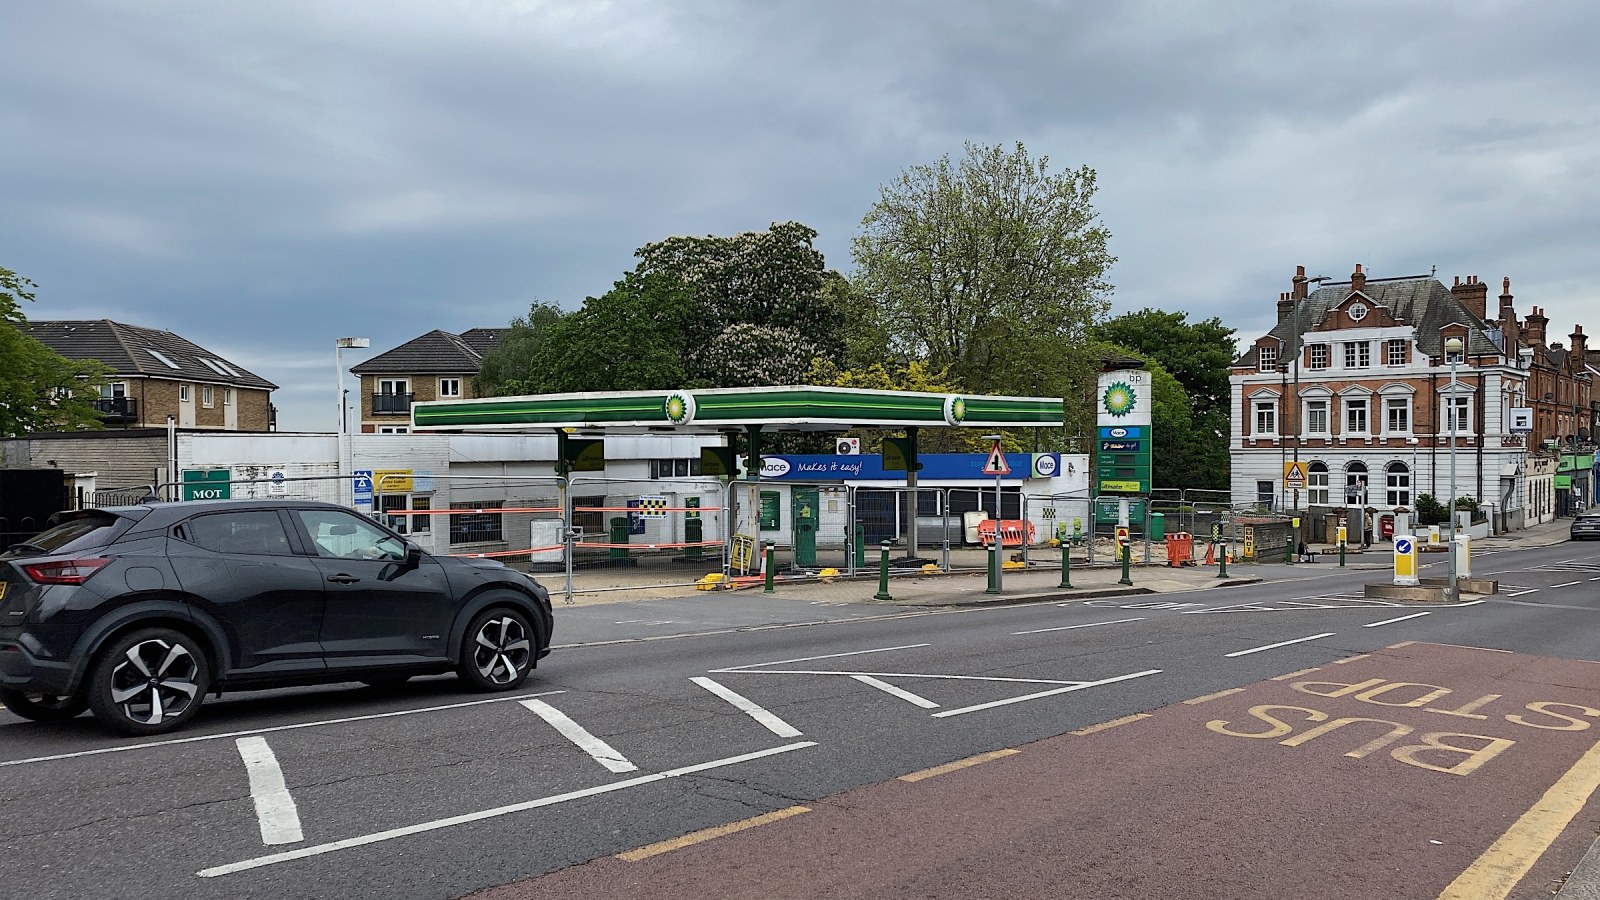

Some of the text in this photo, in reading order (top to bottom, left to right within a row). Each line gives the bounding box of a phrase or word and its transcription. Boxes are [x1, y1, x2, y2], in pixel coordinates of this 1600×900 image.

[1129, 374, 1142, 384] bp
[797, 460, 863, 476] Makes it easy!
[1039, 459, 1054, 470] Mace
[192, 489, 222, 499] MOT
[1289, 678, 1600, 731] STOP
[1205, 704, 1517, 776] BUS
